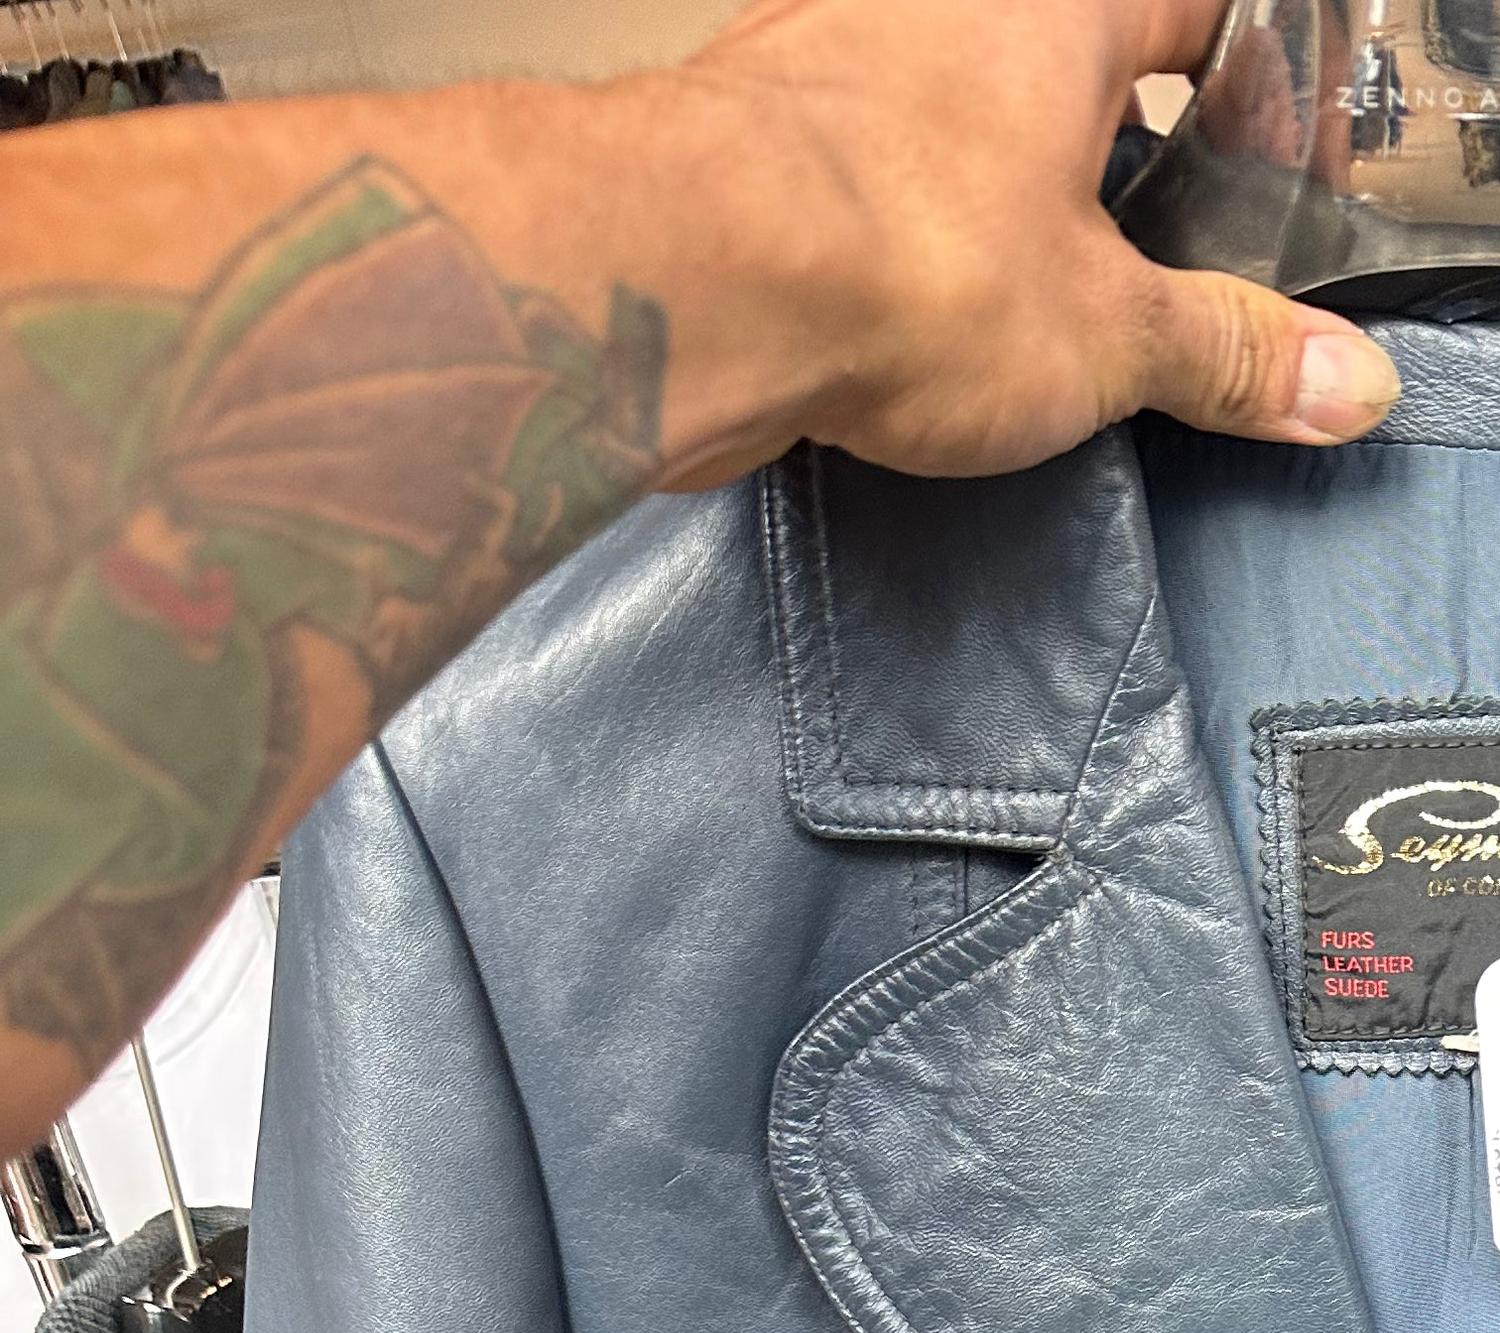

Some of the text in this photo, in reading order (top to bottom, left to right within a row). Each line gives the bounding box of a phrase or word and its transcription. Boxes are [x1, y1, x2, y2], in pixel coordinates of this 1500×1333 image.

[1335, 85, 1465, 110] ZENNO
[1321, 930, 1376, 950] FURS
[1323, 955, 1415, 974] LEATHER
[1324, 977, 1390, 999] SUEDE
